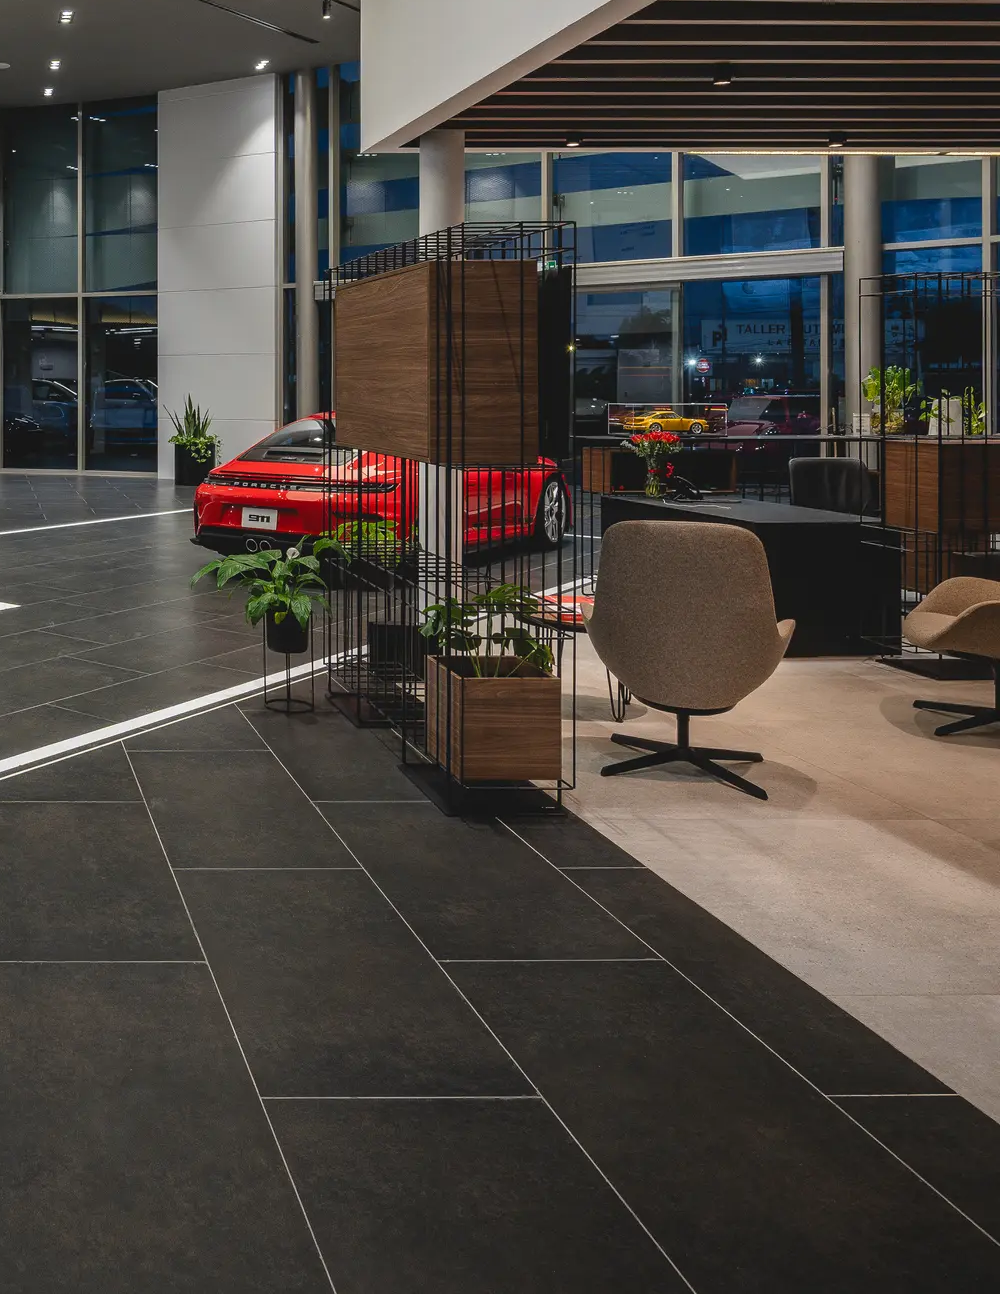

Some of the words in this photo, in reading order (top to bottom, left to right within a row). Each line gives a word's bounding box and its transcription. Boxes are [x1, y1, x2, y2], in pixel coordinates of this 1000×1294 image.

[736, 324, 785, 334] TALLER
[233, 481, 297, 491] PORSCHE
[248, 514, 271, 523] 911
